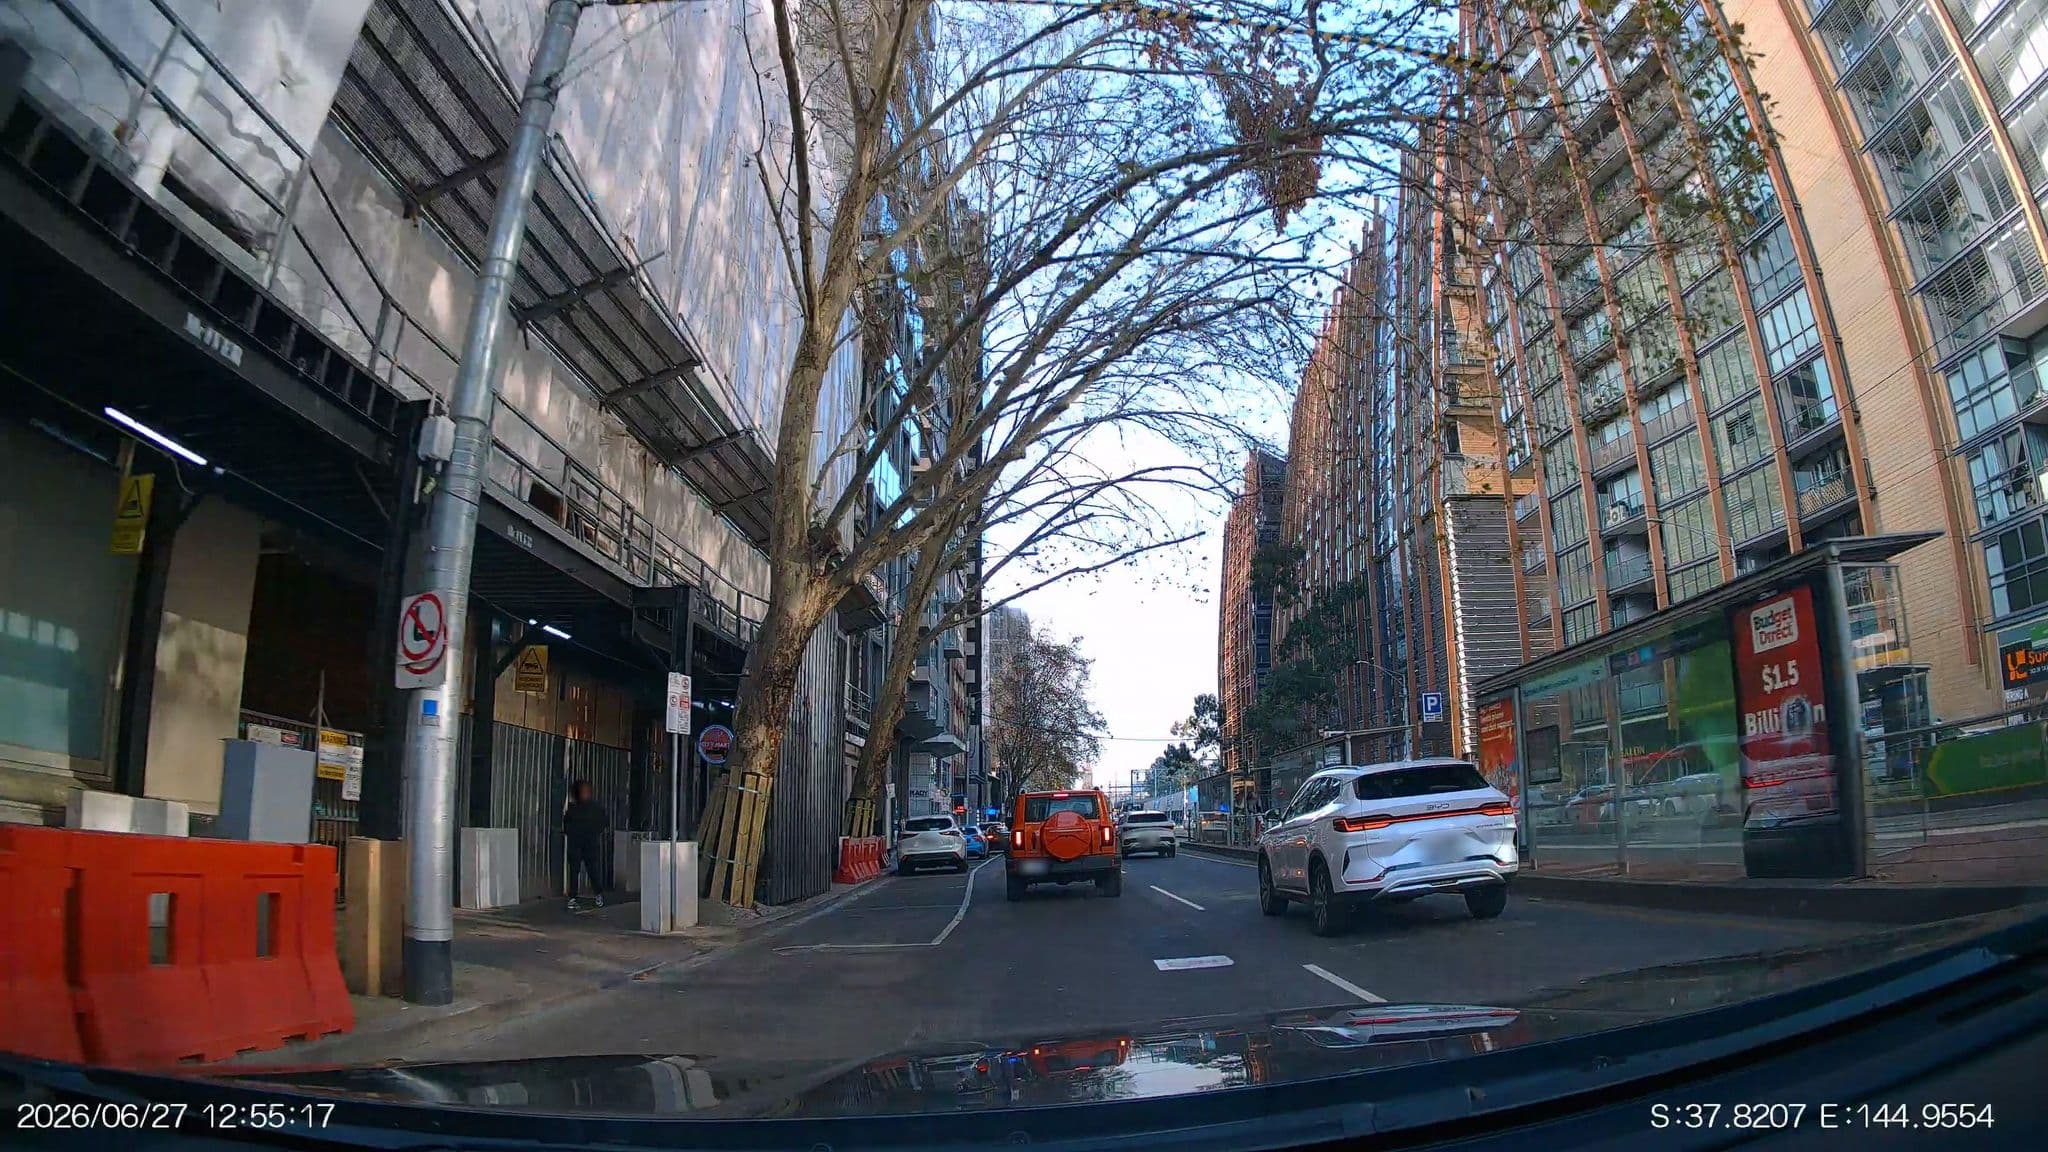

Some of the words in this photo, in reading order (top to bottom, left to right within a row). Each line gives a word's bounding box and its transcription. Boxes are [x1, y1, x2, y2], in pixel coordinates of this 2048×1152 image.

[1753, 606, 1793, 631] Budget
[1758, 624, 1793, 646] Direct
[1762, 659, 1799, 694] $1.5
[1427, 696, 1438, 712] P
[1744, 699, 1826, 736] Billin
[1426, 803, 1450, 812] BYD
